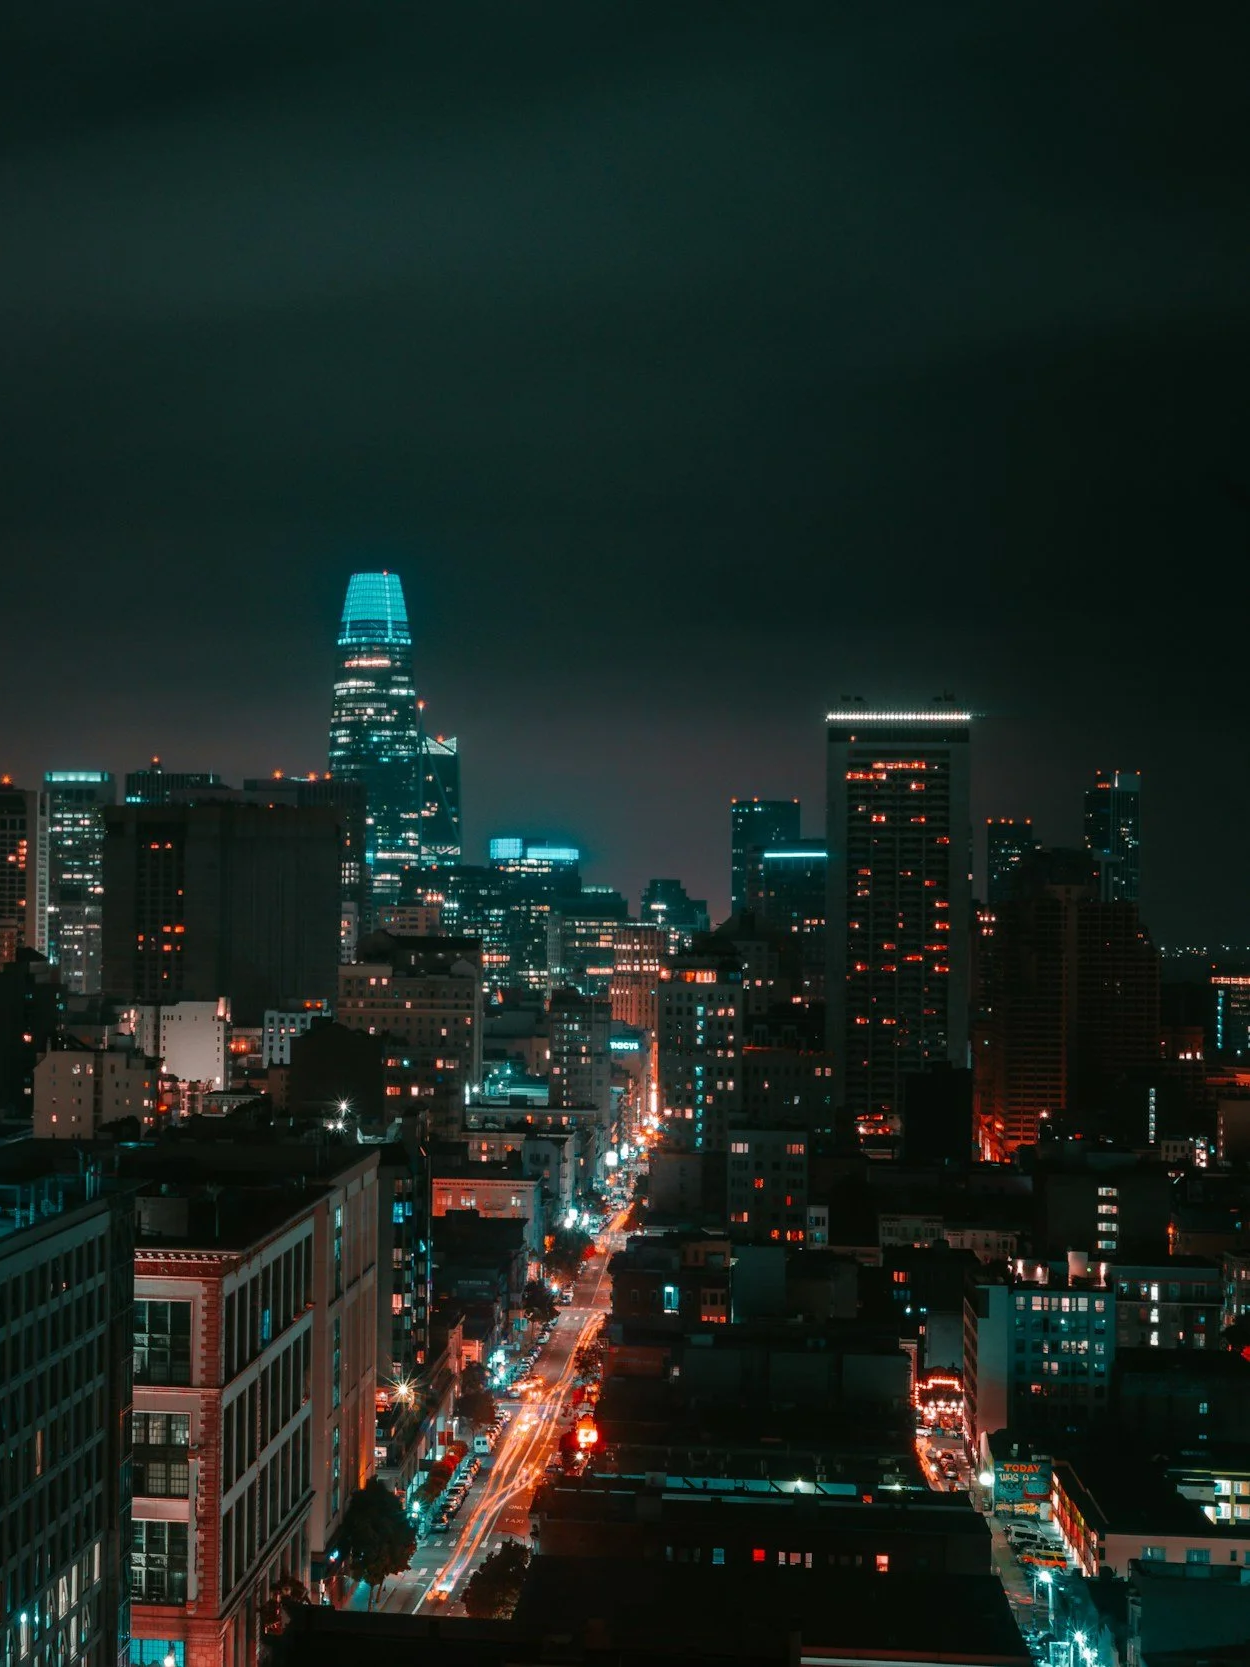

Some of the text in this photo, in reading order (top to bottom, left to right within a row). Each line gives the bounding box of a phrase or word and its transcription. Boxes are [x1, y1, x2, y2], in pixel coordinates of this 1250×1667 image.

[1004, 1463, 1041, 1473] TODAY
[999, 1473, 1030, 1482] WAS A
